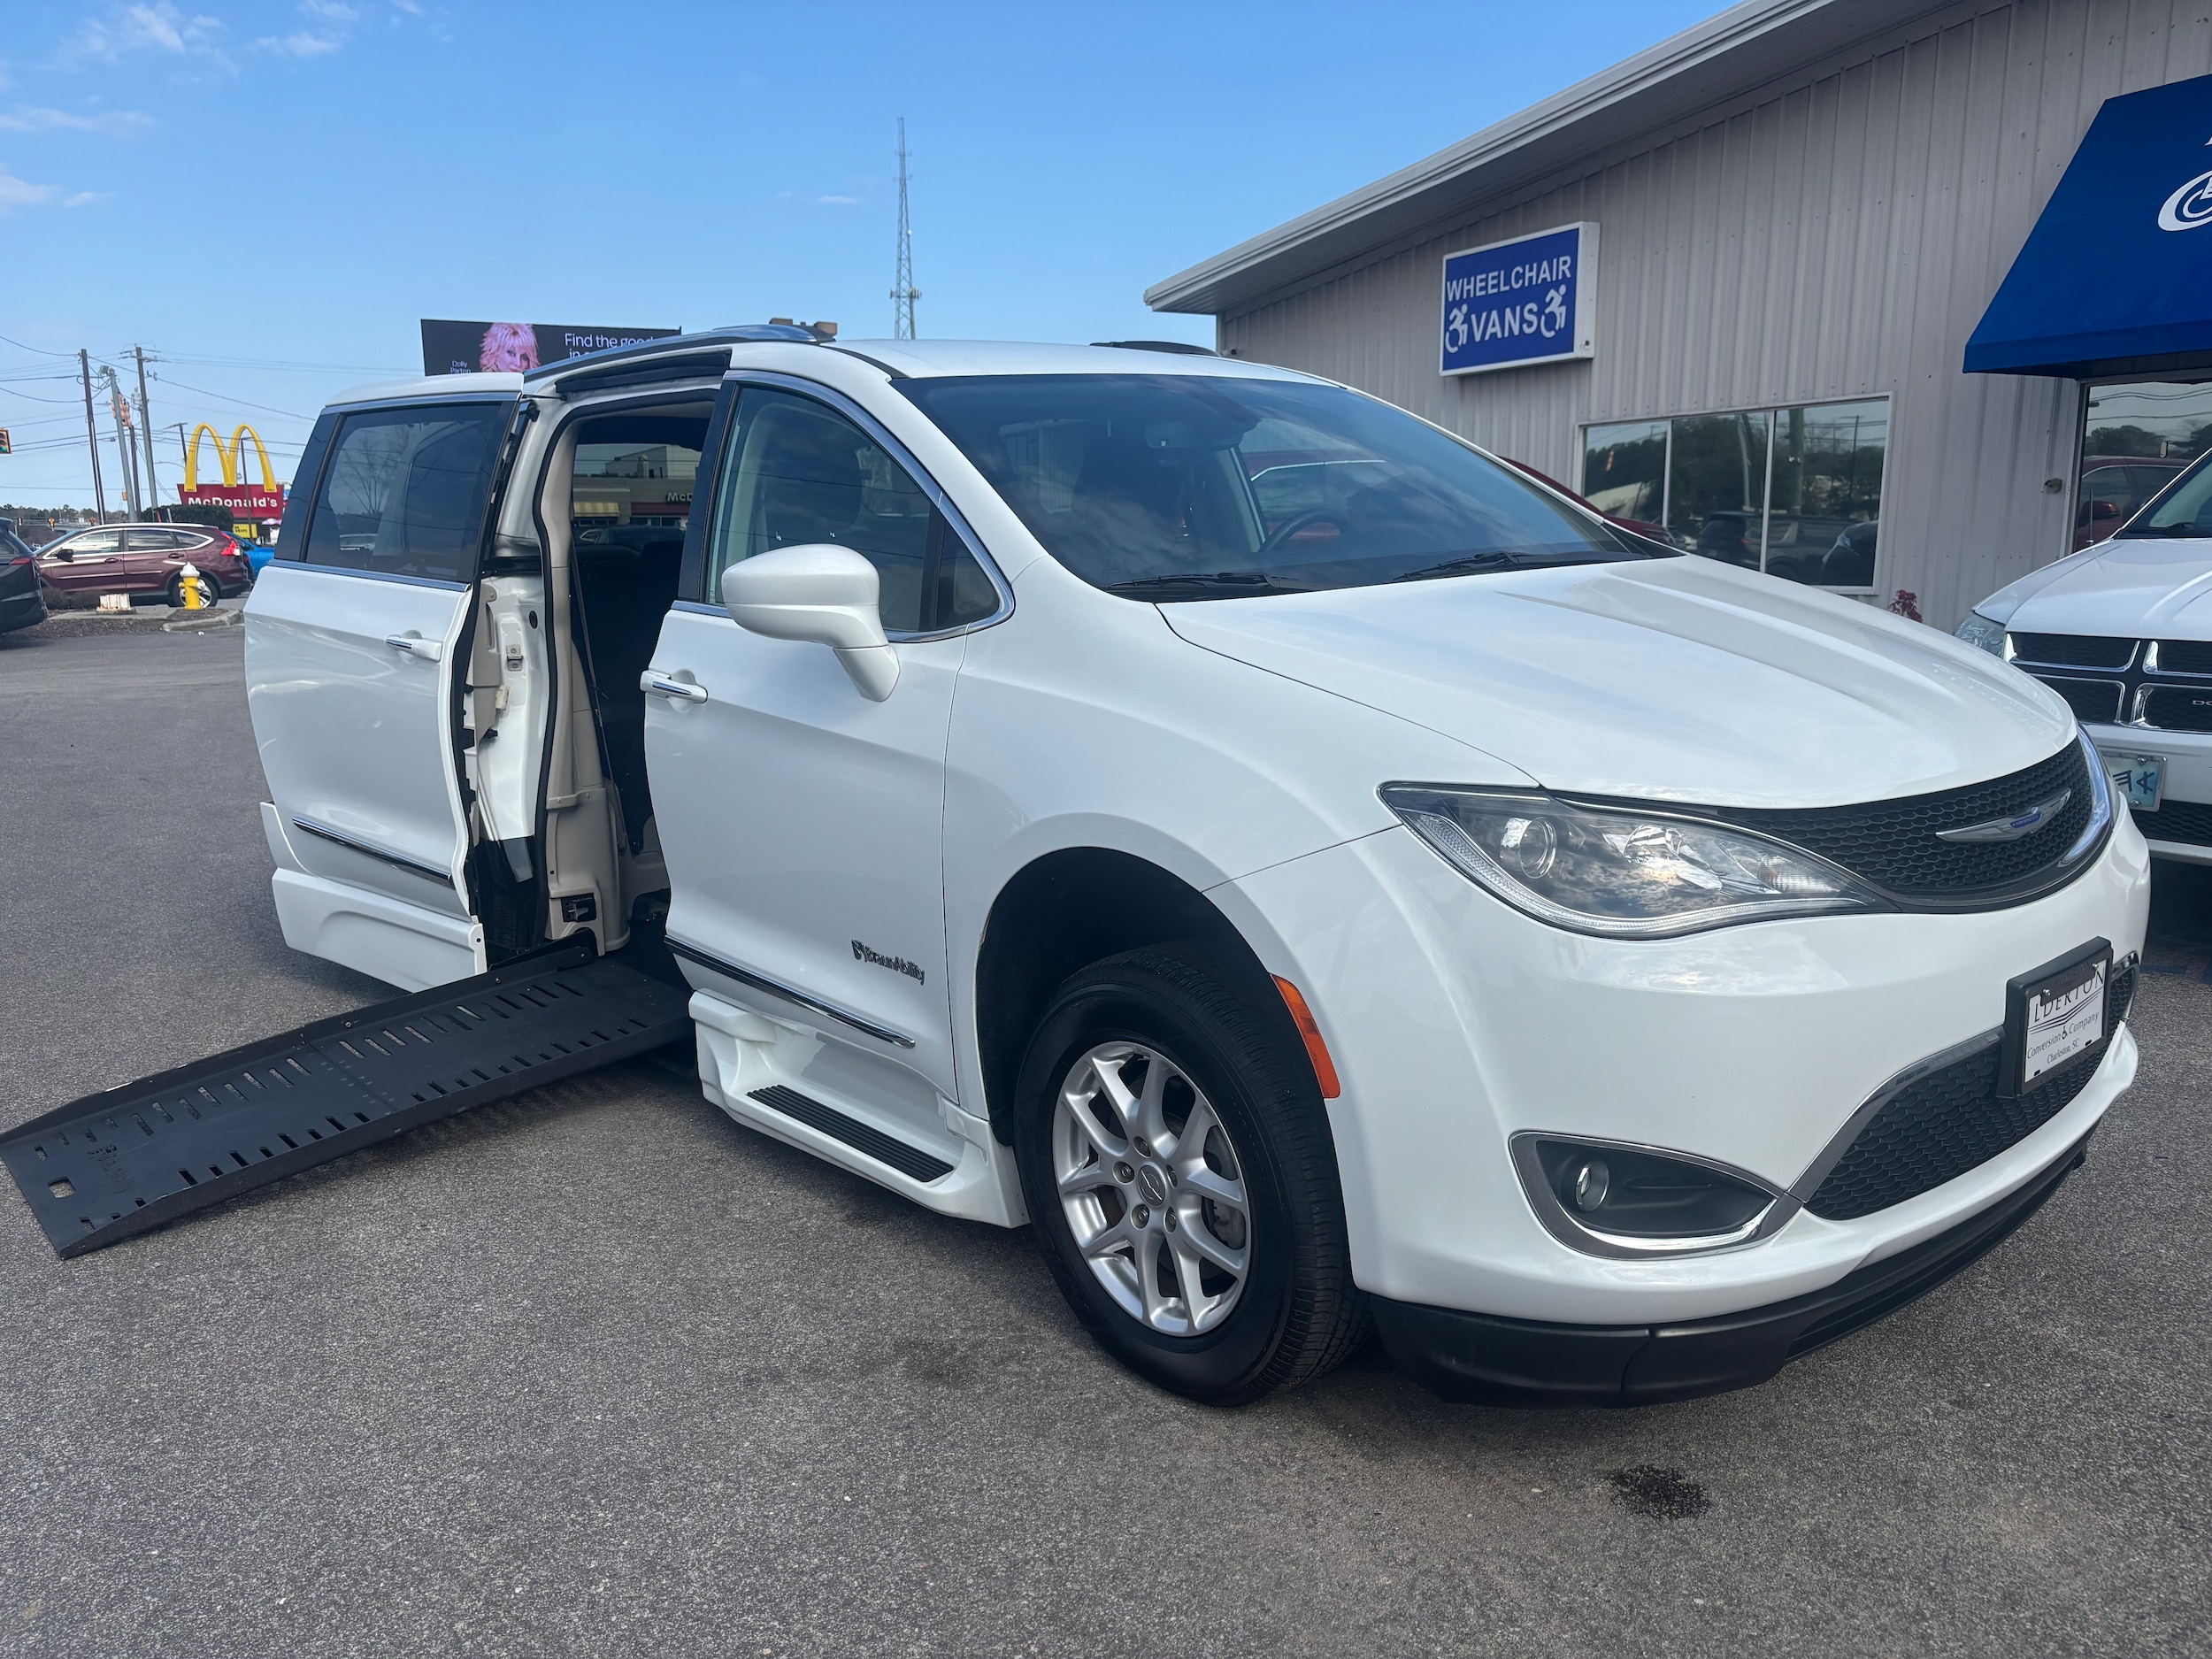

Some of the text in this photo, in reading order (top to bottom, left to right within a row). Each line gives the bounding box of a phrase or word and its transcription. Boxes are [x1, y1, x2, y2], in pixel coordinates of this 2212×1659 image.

[1447, 256, 1571, 302] WHEELCHAIR
[565, 333, 593, 348] Find
[595, 334, 618, 348] the
[1471, 303, 1539, 342] VANS
[2027, 1011, 2100, 1059] Conversion Company
